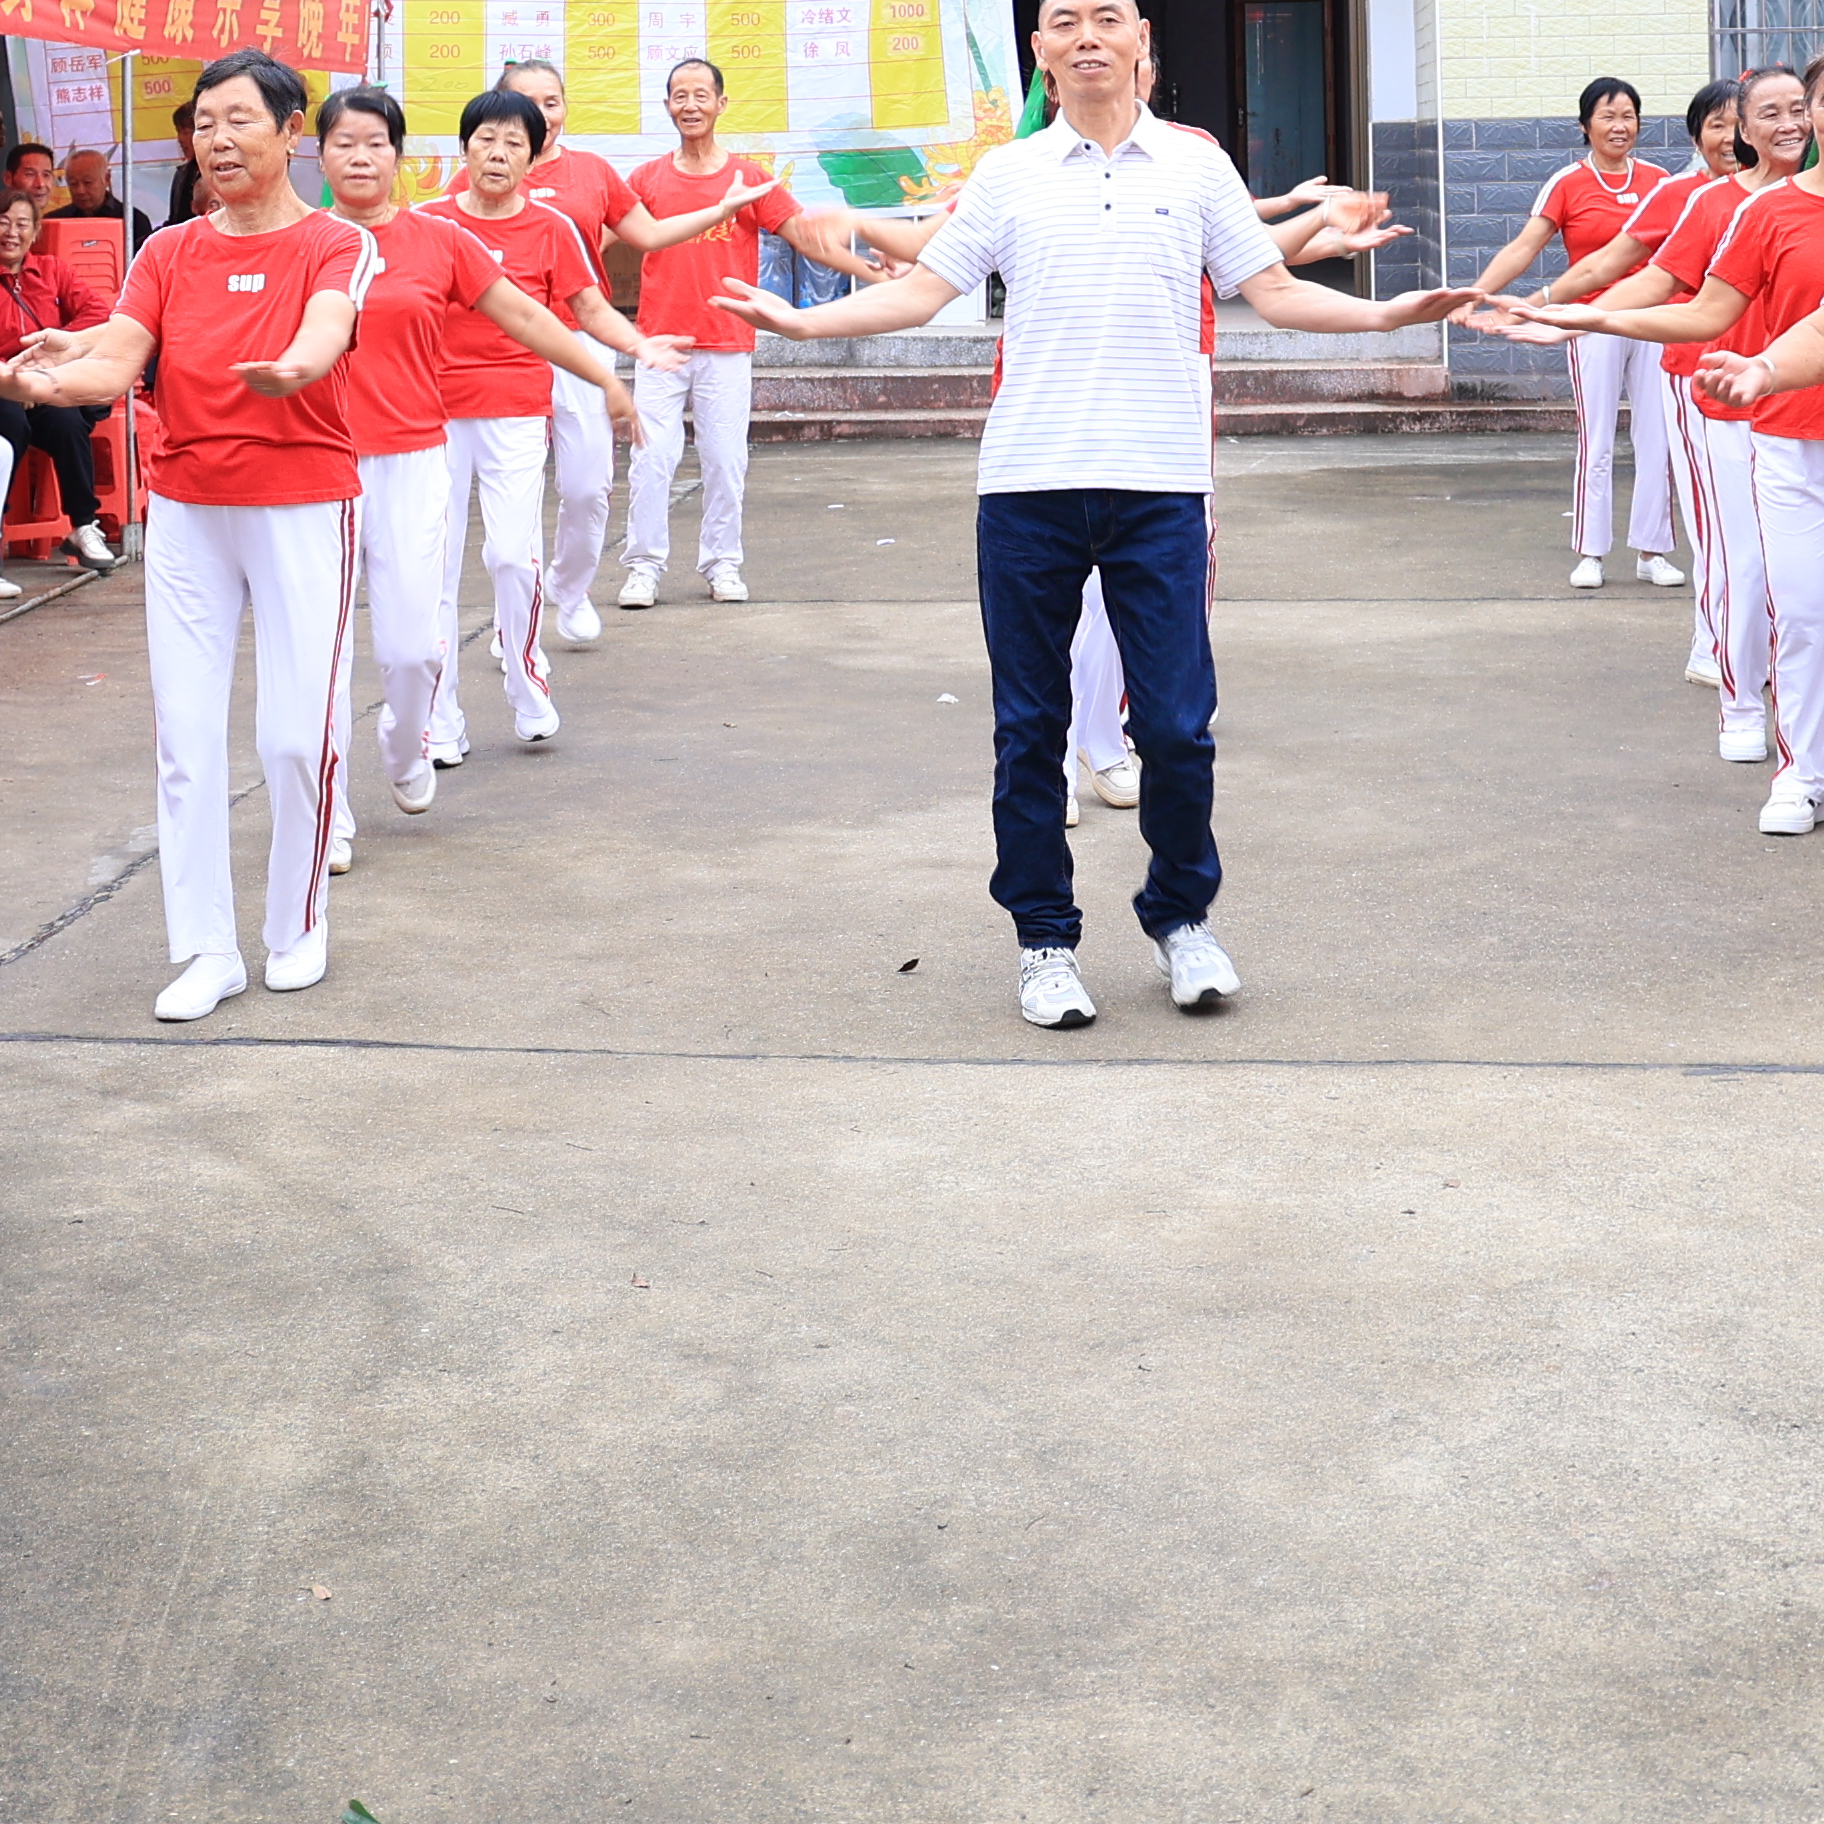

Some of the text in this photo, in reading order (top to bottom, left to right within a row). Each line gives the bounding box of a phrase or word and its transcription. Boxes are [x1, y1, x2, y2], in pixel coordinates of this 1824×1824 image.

[429, 11, 461, 25] 200
[890, 3, 925, 19] 1000
[588, 12, 615, 27] 300
[730, 12, 761, 27] 500
[430, 44, 460, 58] 200
[892, 36, 919, 51] 200
[588, 46, 617, 60] 500
[730, 44, 760, 59] 500
[51, 54, 103, 73] 顾岳军
[56, 85, 104, 103] 熊志祥
[144, 80, 171, 95] 500
[227, 273, 266, 293] sup
